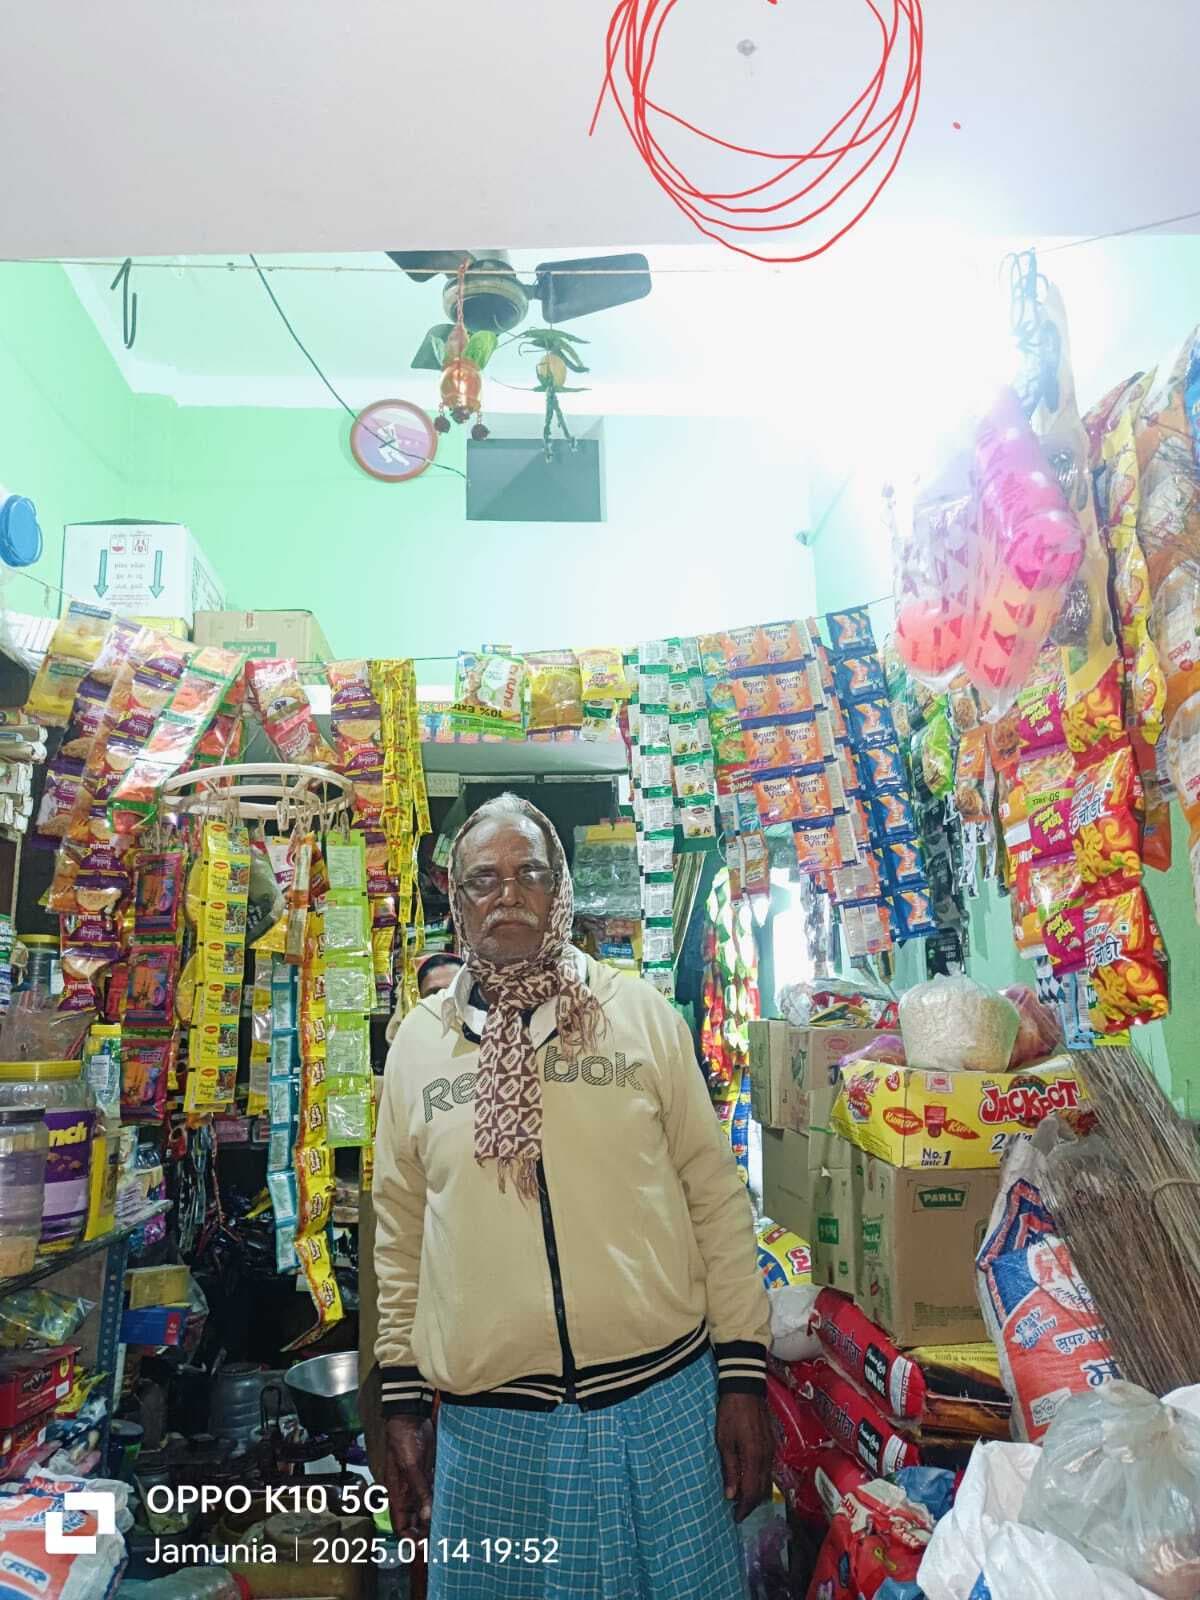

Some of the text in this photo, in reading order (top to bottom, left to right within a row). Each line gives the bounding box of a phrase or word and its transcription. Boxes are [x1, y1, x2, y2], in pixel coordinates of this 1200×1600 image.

[422, 1046, 644, 1123] Rebok
[979, 1079, 1078, 1124] JACKPOT
[921, 1158, 942, 1167] taste
[922, 1148, 952, 1166] No. 1
[923, 1192, 962, 1203] PARLE
[1055, 1332, 1086, 1353] सुपर
